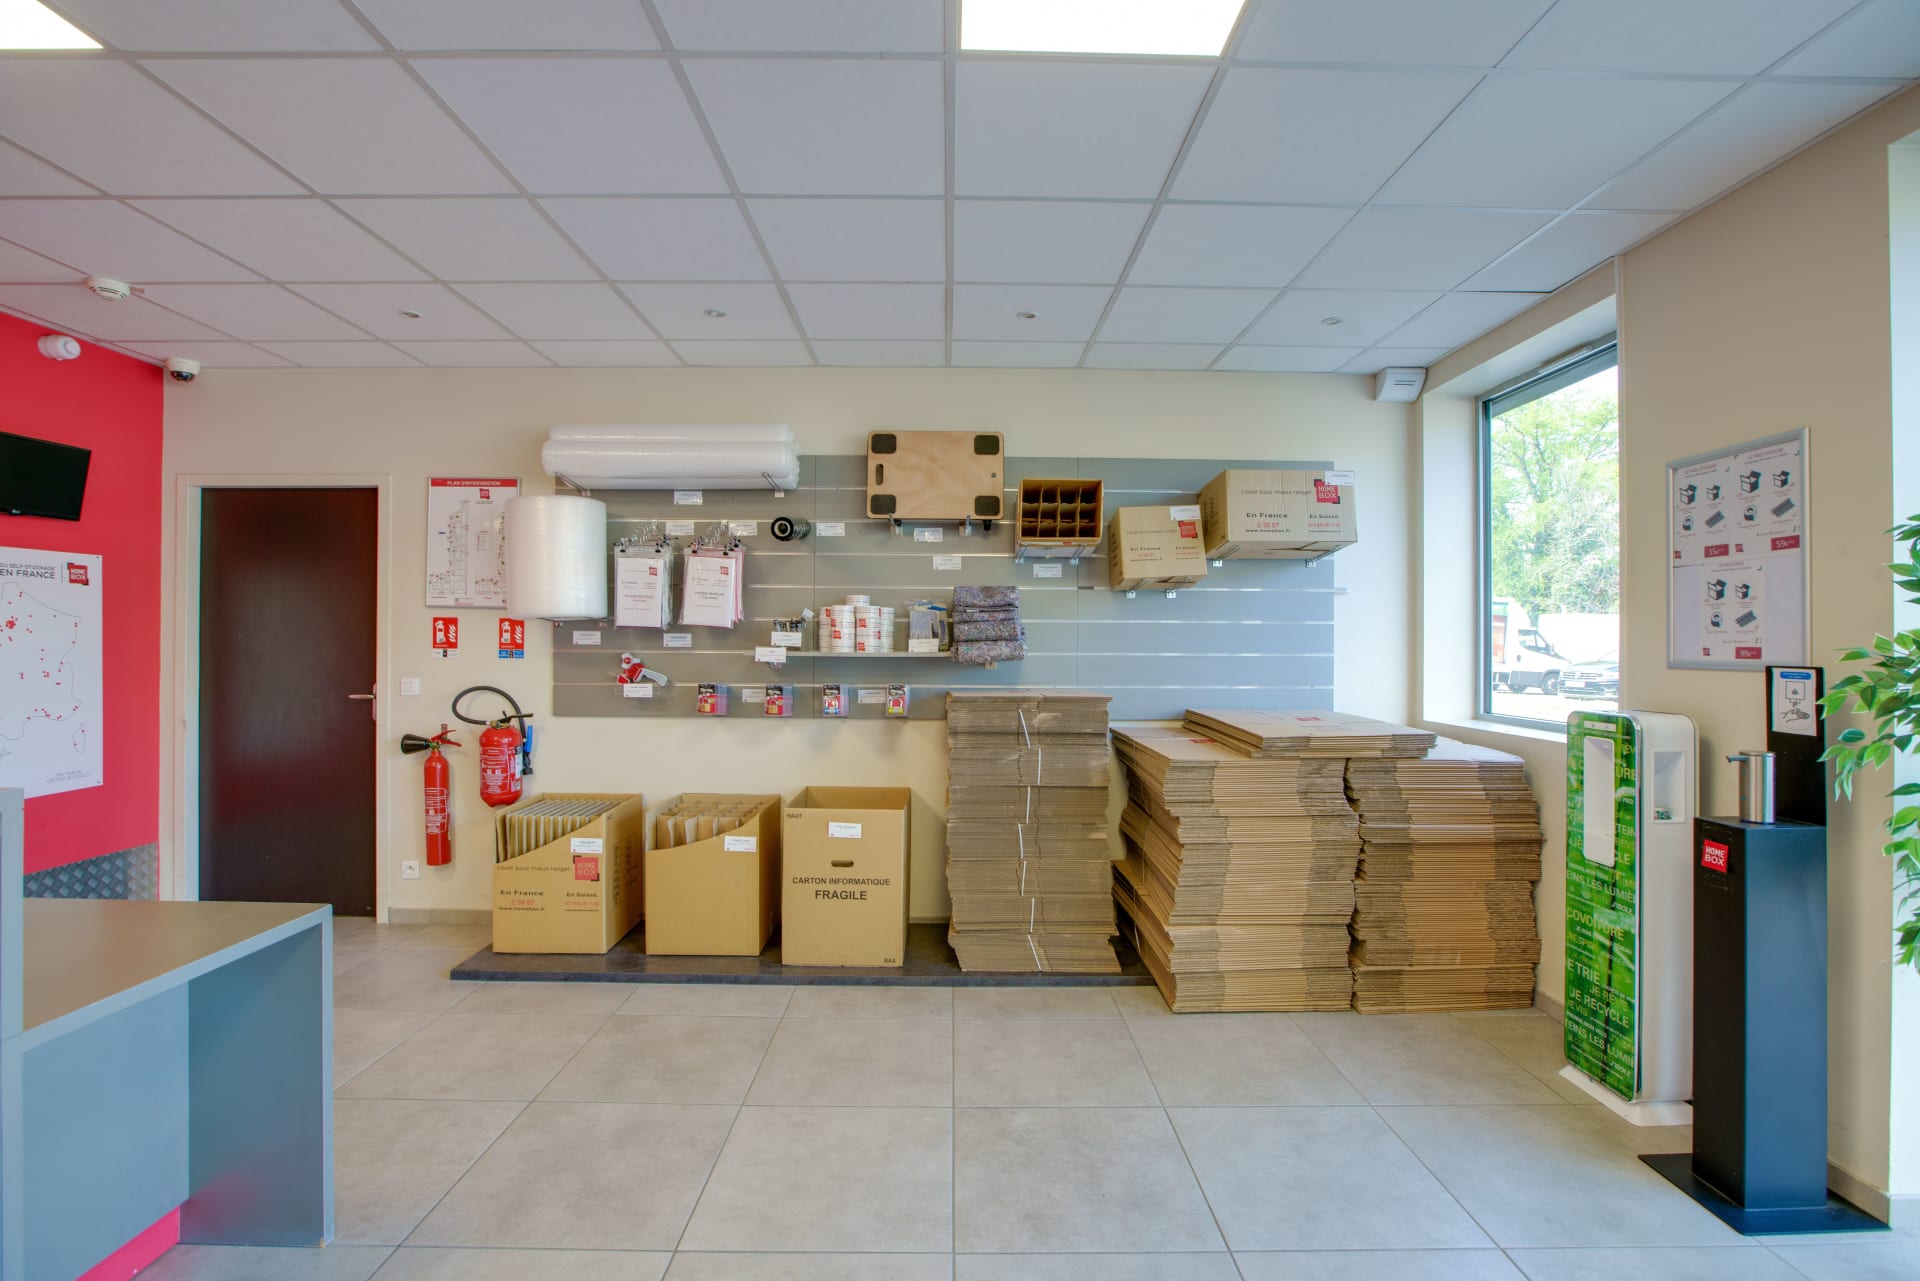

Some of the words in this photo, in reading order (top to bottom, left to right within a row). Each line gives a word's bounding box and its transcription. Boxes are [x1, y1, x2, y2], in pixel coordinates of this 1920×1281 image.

[0, 568, 13, 577] EN
[16, 569, 55, 579] FRANCE
[1705, 846, 1725, 857] HOME
[1704, 854, 1725, 866] BOX
[577, 868, 595, 876] BOX
[792, 876, 826, 885] CARTON
[828, 877, 891, 886] INFORMATIQUE
[815, 889, 868, 901] FRAGILE
[1567, 907, 1624, 941] COVOITURE
[1576, 961, 1600, 985] TRIE
[1570, 987, 1582, 1002] JE
[1584, 994, 1630, 1029] RECYCLE
